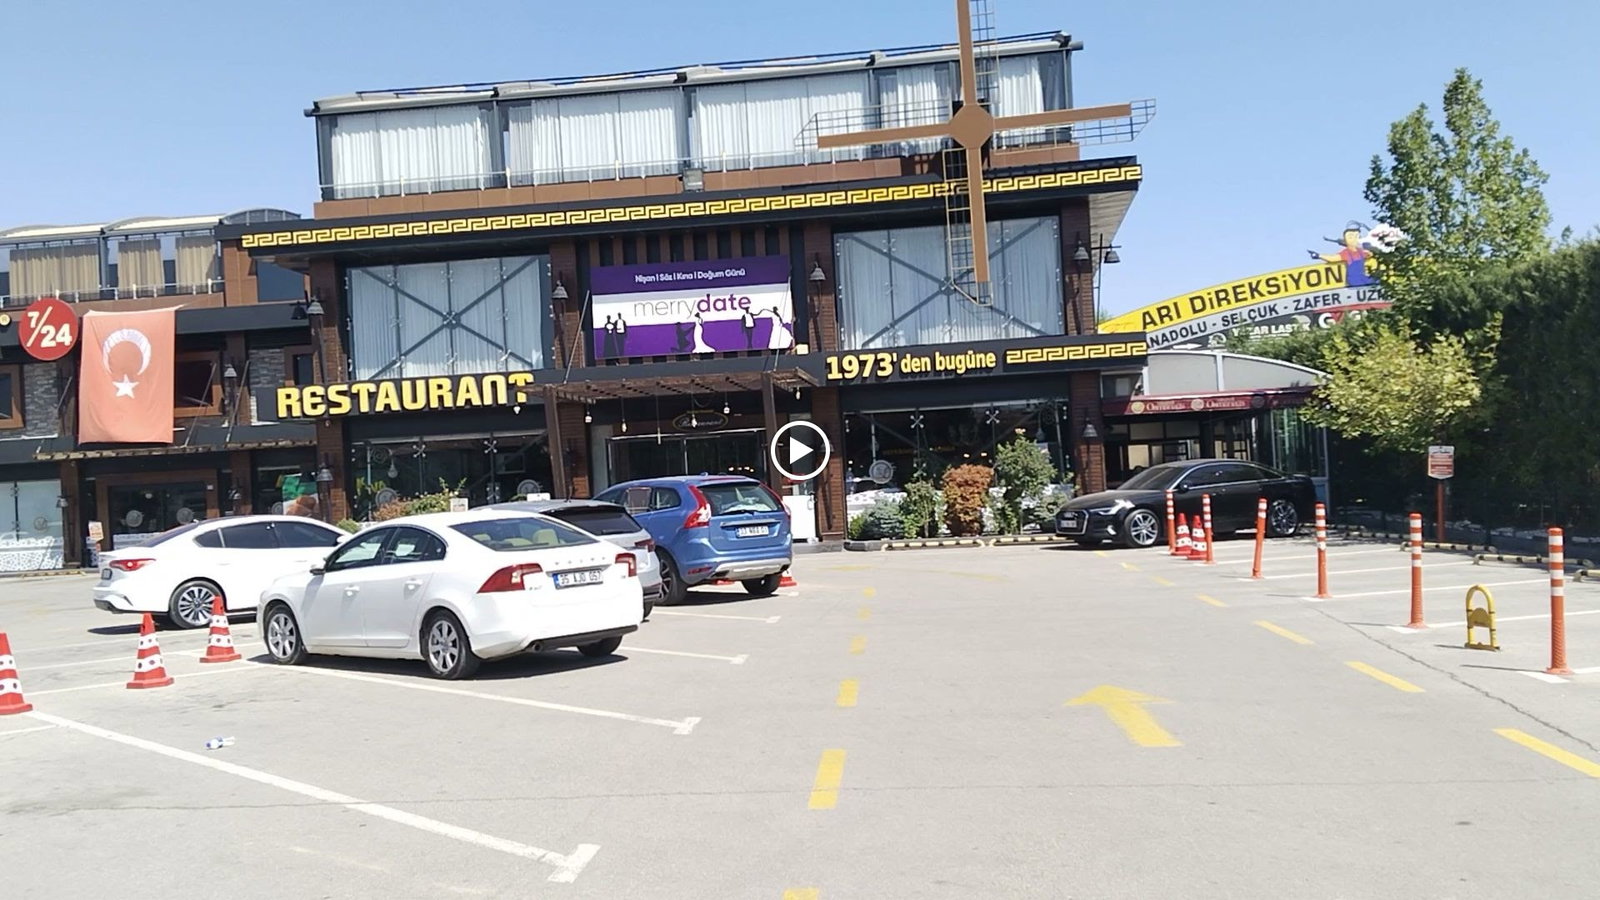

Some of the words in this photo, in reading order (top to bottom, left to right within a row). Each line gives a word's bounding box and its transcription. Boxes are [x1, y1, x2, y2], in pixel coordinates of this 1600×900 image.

[633, 294, 752, 320] merrydate
[1142, 301, 1182, 330] ARI
[1293, 293, 1341, 312] ZAFER
[27, 306, 73, 348] 7/24
[901, 353, 931, 373] den
[935, 350, 996, 374] bugüne
[277, 373, 534, 418] RESTAURANT
